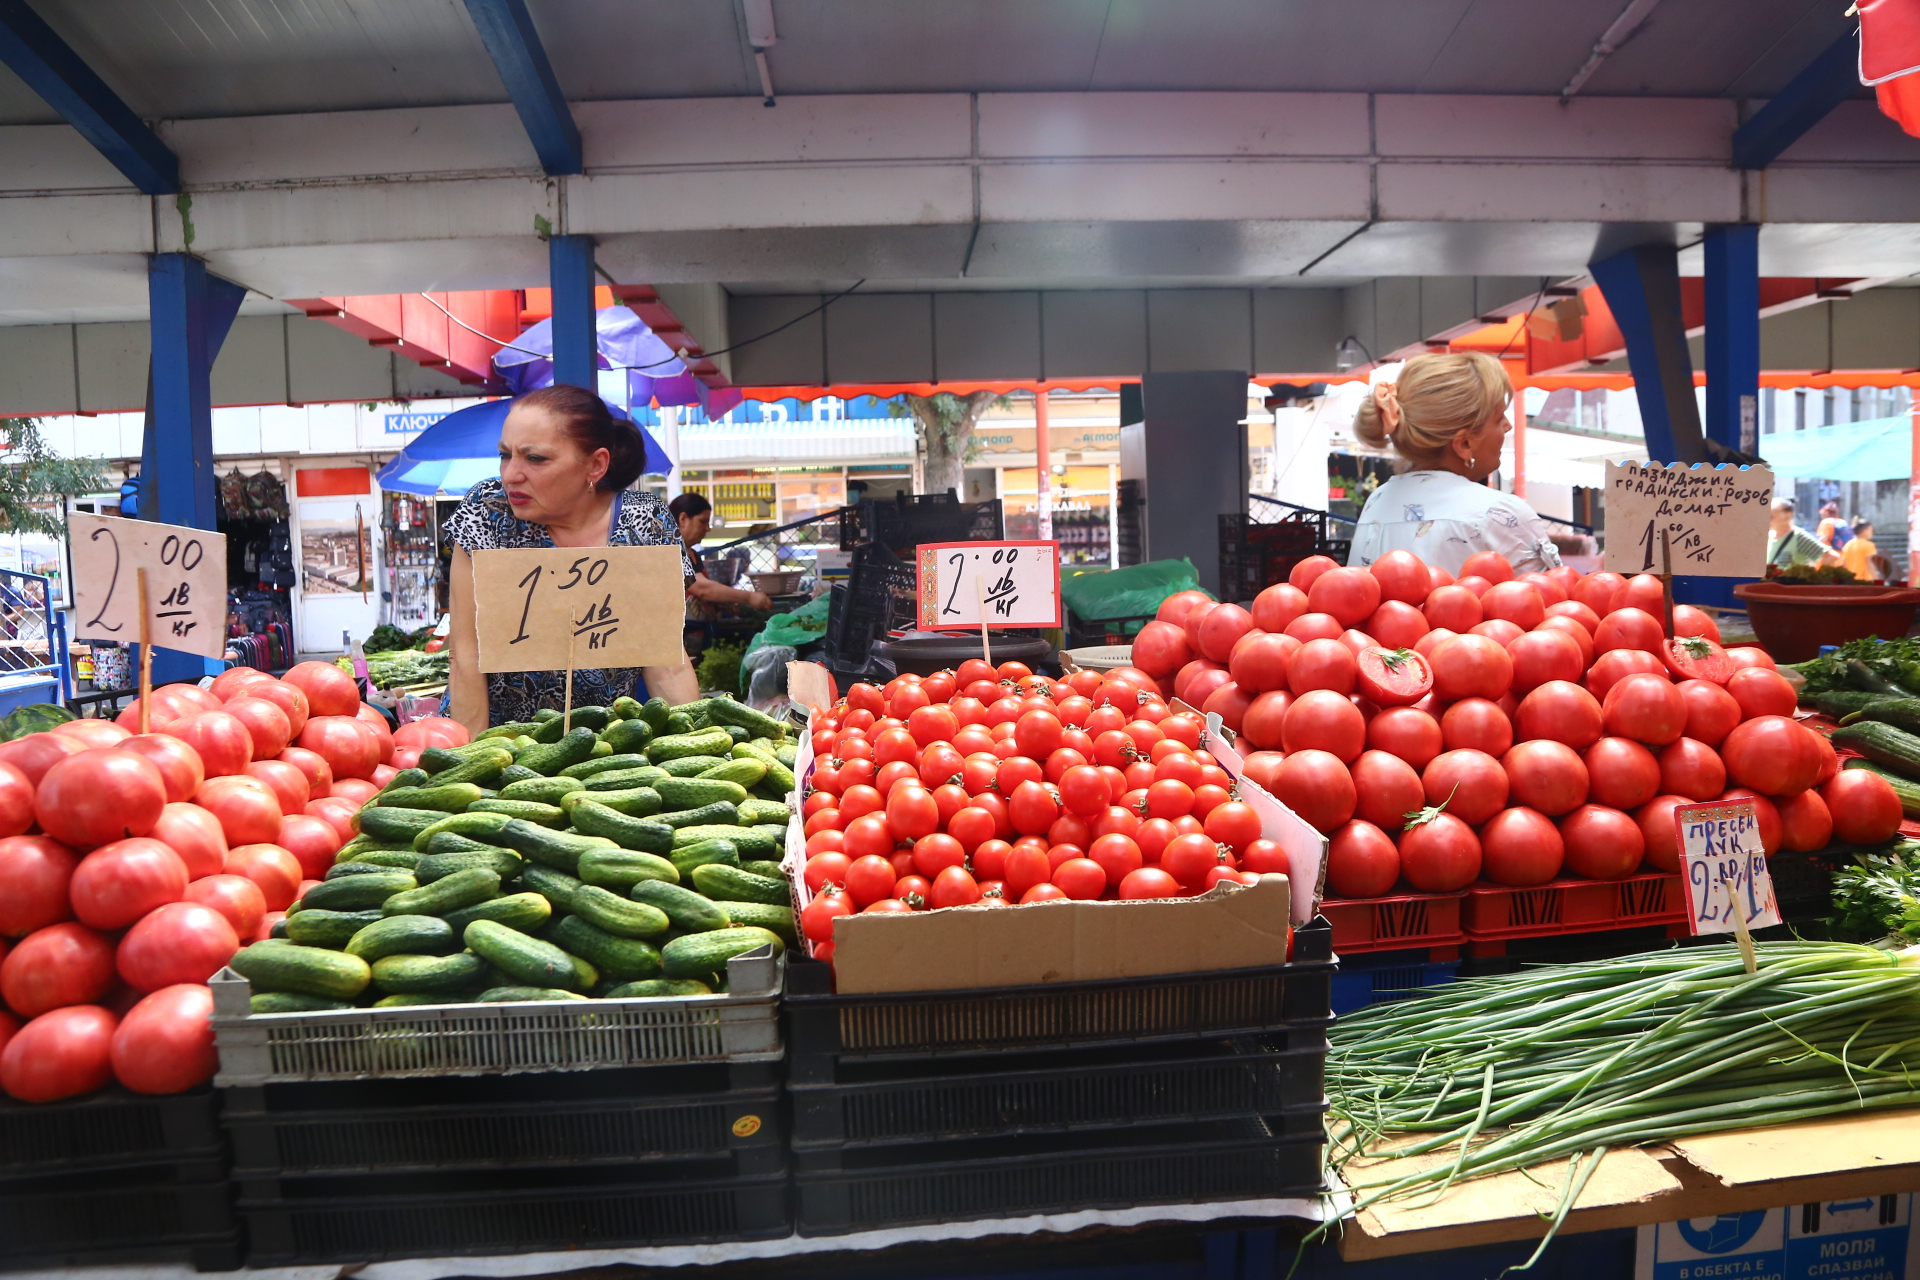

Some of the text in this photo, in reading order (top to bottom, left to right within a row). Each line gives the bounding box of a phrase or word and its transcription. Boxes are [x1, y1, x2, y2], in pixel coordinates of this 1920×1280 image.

[389, 415, 446, 431] КЛЮЧ
[1083, 433, 1120, 442] ALMON
[1026, 500, 1091, 512] КАКАВАЛ
[1655, 499, 1732, 518] ДОМАТ
[1689, 814, 1754, 839] ПРЕСЕН
[1820, 1238, 1876, 1258] МОЛЯ
[1679, 1267, 1689, 1279] В
[1695, 1261, 1752, 1278] ОБЕКТА
[1755, 1259, 1765, 1271] Е
[1808, 1256, 1885, 1277] СПАЗВАЙ
